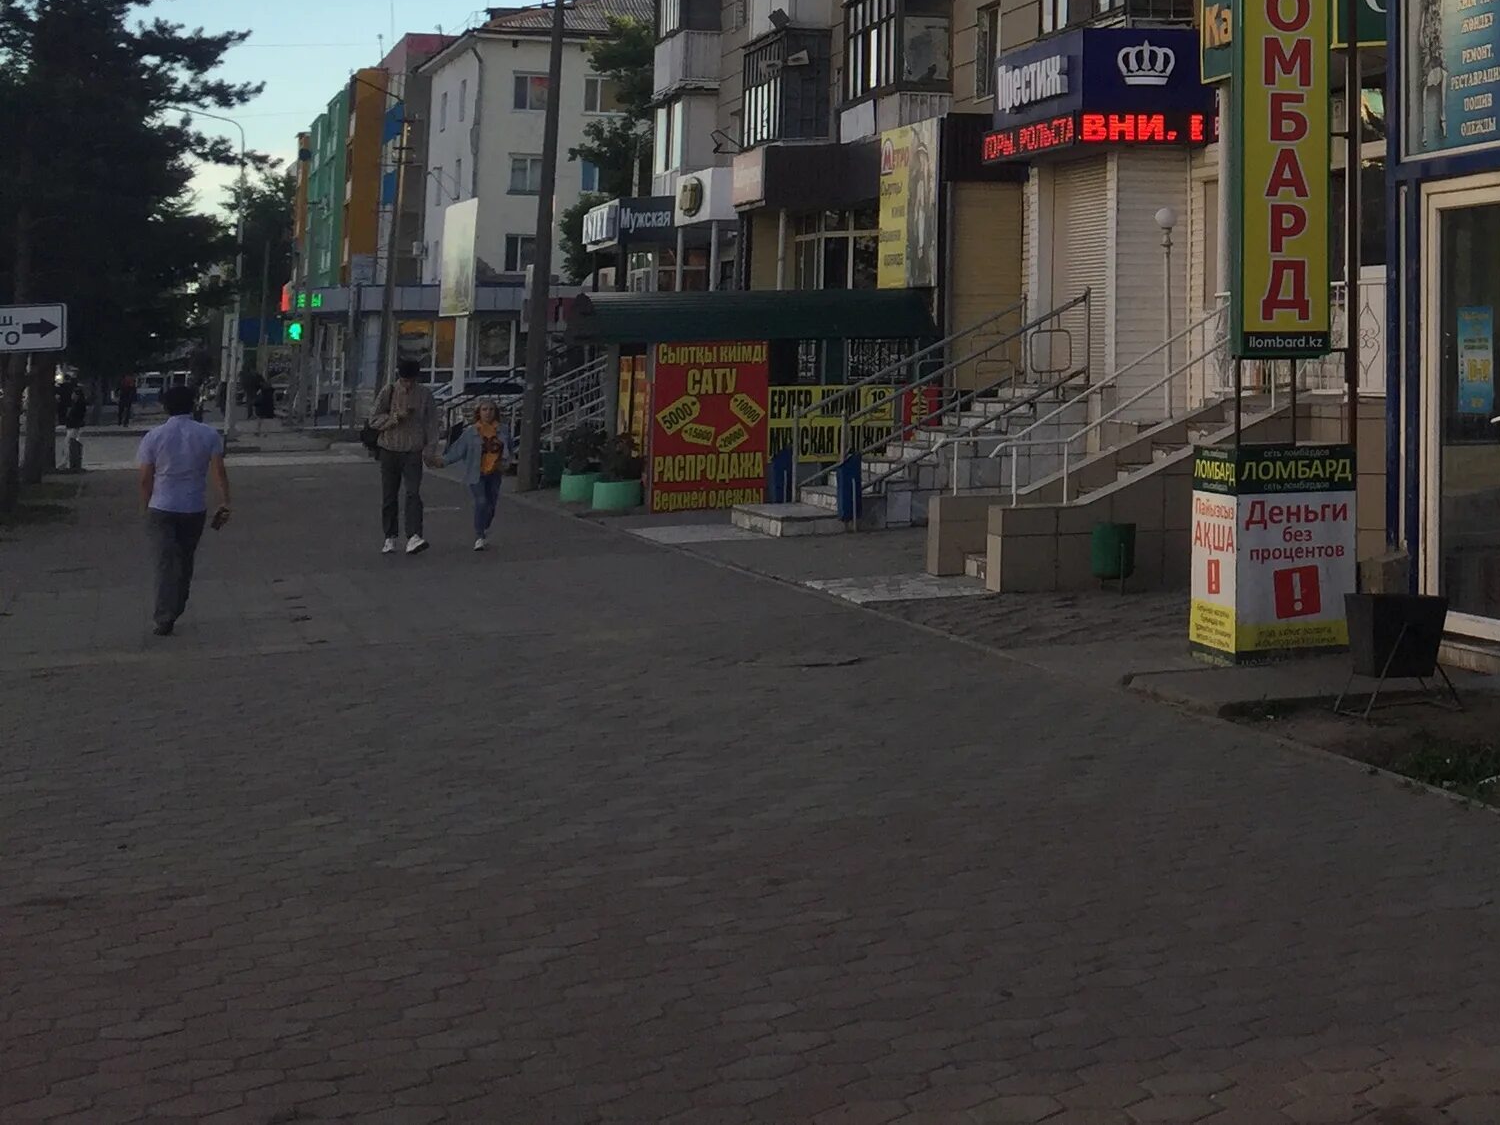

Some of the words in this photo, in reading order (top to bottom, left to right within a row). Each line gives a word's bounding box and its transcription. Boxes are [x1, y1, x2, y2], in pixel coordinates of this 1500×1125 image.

[998, 55, 1065, 114] Престиж
[620, 208, 671, 233] Мужская
[687, 368, 736, 395] САТУ
[662, 402, 693, 430] 5000
[654, 452, 763, 483] РАСПРОДАЖА
[1194, 459, 1236, 486] ЛОМБАРД
[1241, 458, 1352, 482] ЛОМБАРД
[653, 488, 708, 512] Верхней
[1245, 500, 1348, 531] Деньги
[1194, 521, 1234, 555] АҚША
[1283, 526, 1312, 542] без
[1250, 544, 1345, 564] процентов
